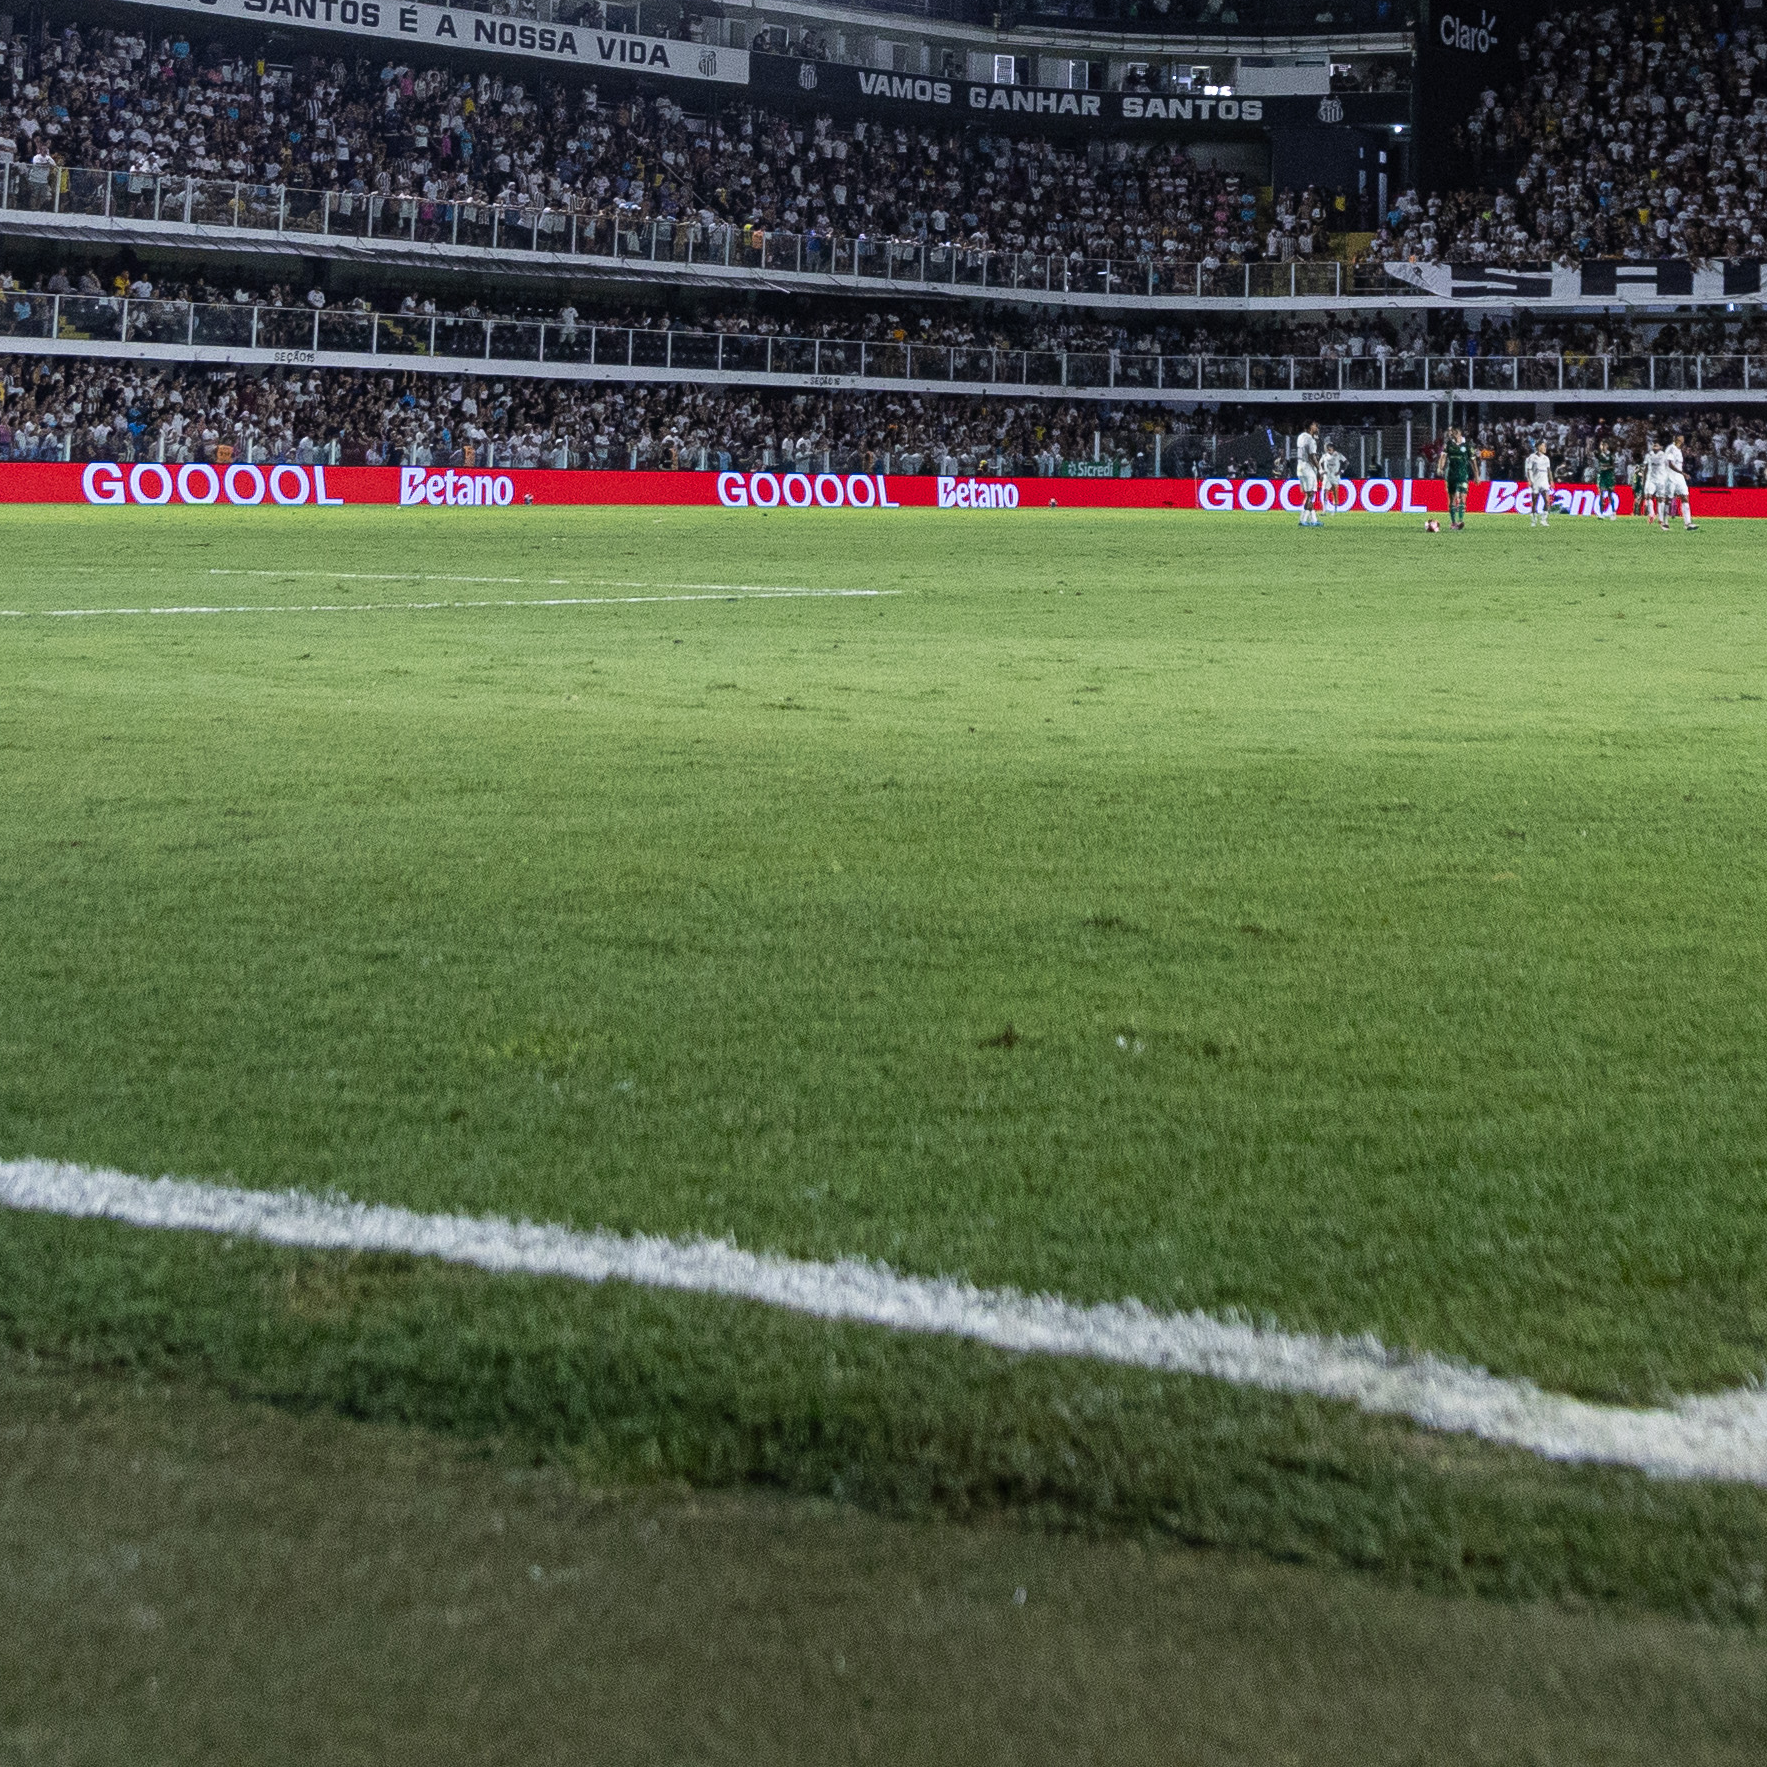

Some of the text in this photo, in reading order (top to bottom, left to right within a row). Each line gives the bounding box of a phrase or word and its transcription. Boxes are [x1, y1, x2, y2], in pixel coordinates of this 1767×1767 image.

[435, 12, 458, 39] A
[474, 16, 578, 55] NOSSA
[597, 36, 672, 70] VIDA
[1440, 13, 1491, 54] Claro
[858, 70, 1263, 122] VAMOS GANHAR SANTOS
[81, 462, 345, 505] GOOOOL
[400, 466, 515, 506] Betano
[717, 471, 900, 507] GOOOOL
[1077, 461, 1114, 477] Sicredi
[937, 476, 1020, 509] Betano
[1485, 481, 1620, 517] Beano
